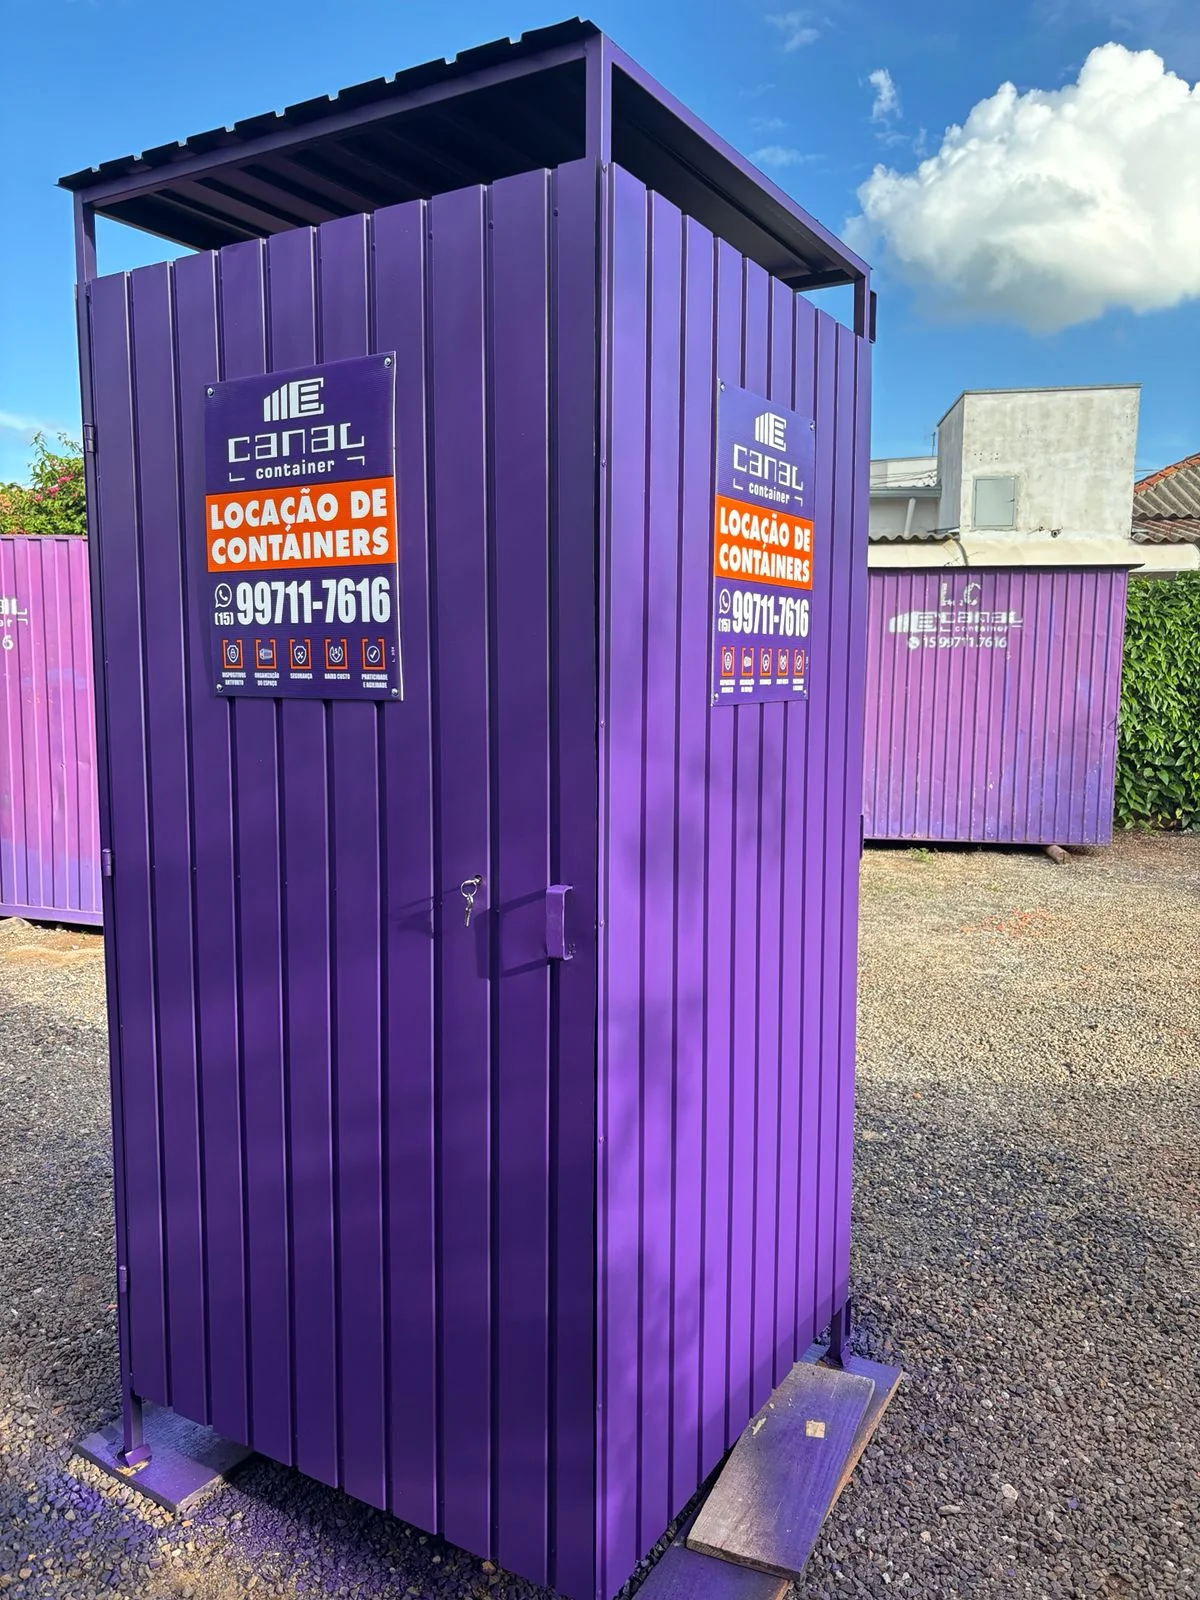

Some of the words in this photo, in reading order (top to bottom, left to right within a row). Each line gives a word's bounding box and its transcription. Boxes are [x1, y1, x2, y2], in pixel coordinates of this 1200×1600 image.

[255, 459, 335, 480] container
[210, 487, 339, 532] LOCAÇÃO
[350, 488, 388, 519] DE
[748, 480, 790, 505] container
[210, 526, 389, 565] CONTAINERS
[719, 506, 790, 550] LOCAÇÃO
[793, 525, 811, 553] DE
[719, 543, 810, 583] CONTAINERS
[214, 611, 235, 626] (15)
[236, 576, 391, 626] 99711-7616
[732, 590, 810, 638] 99711-7616
